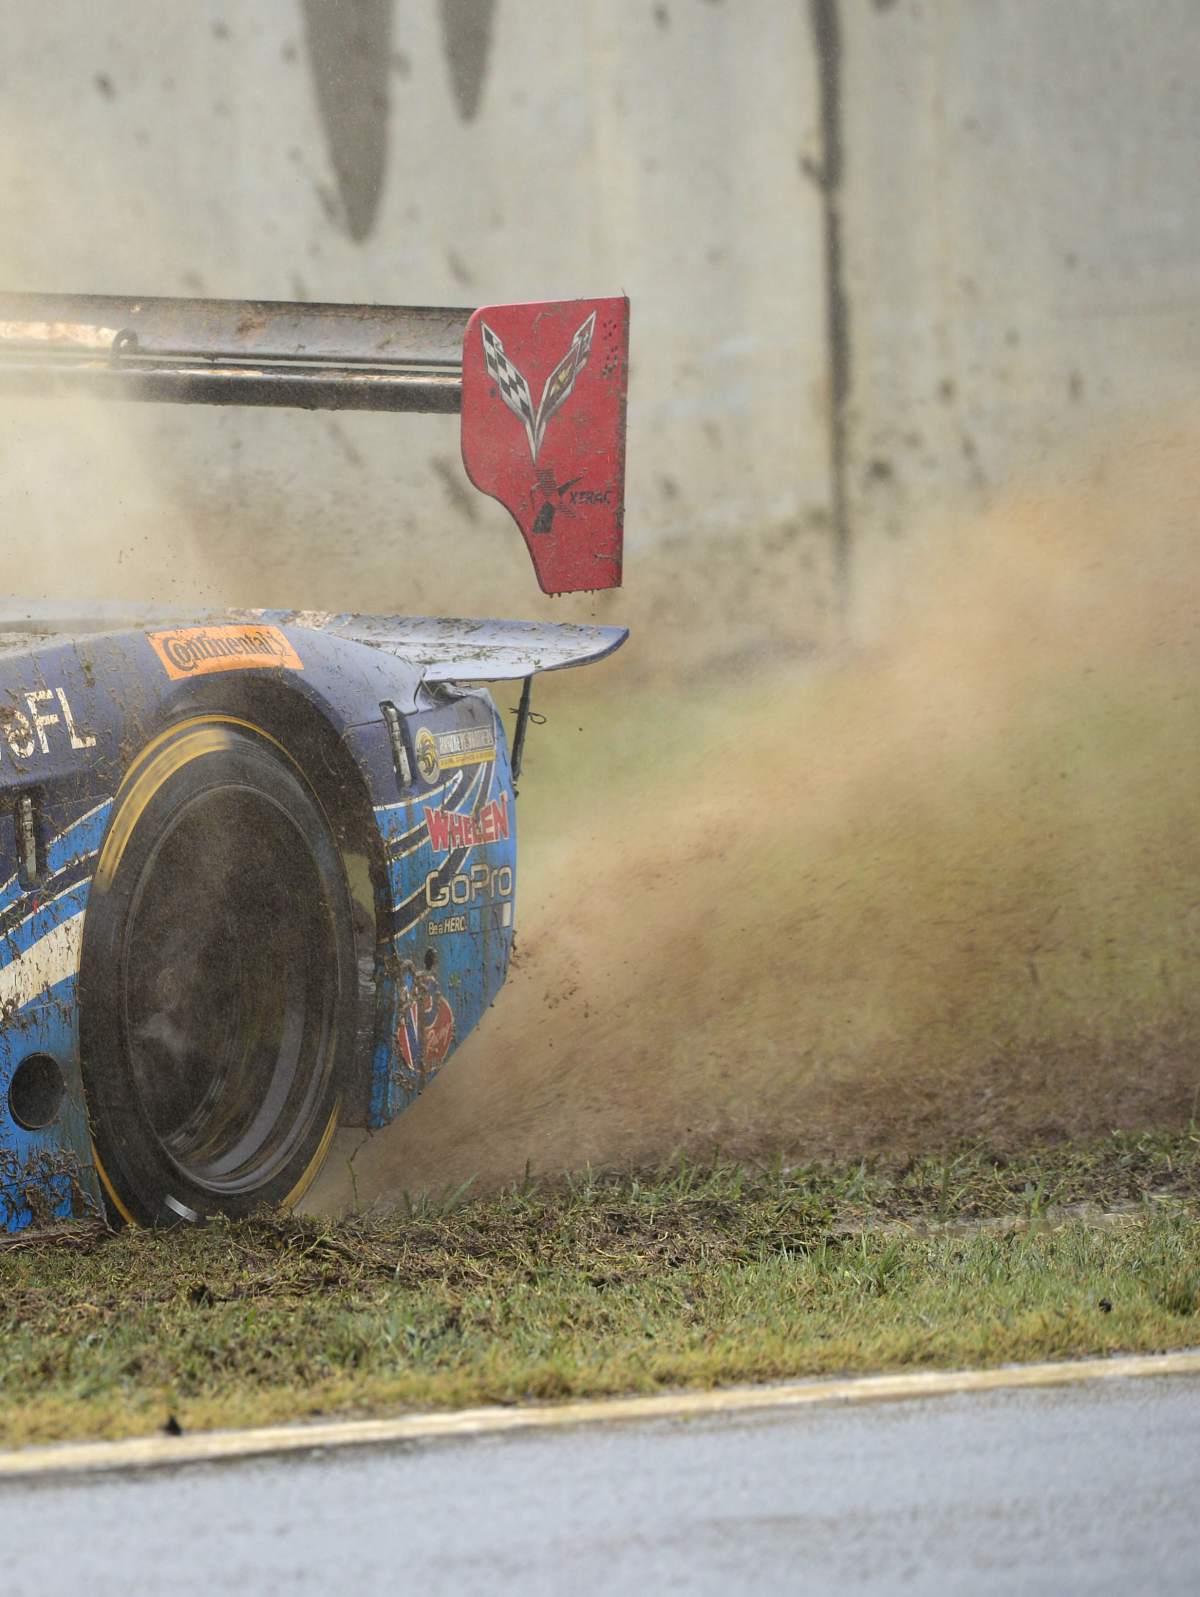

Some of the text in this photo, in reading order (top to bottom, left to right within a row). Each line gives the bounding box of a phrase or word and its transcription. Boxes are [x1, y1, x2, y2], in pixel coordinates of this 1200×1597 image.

[162, 629, 272, 672] Continental
[424, 791, 510, 853] WHELEN
[426, 864, 512, 908] GoPro
